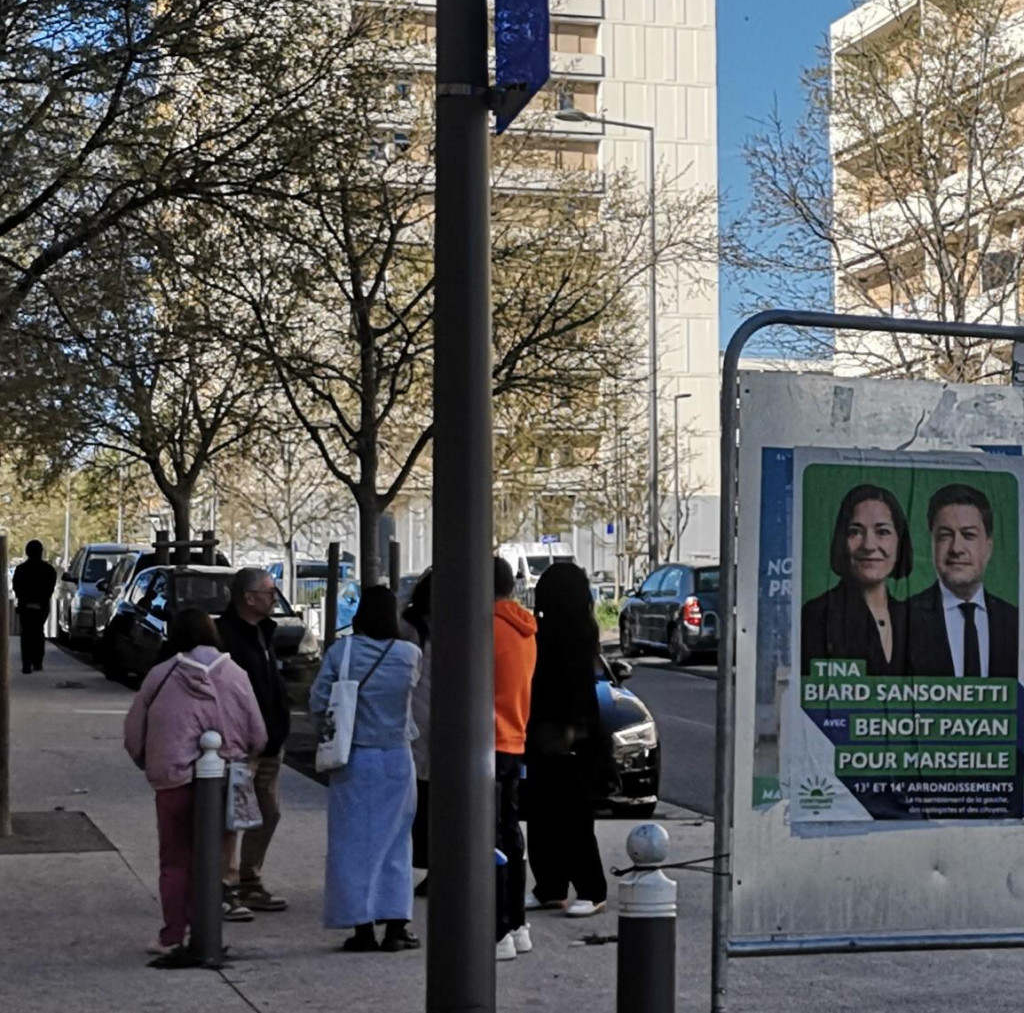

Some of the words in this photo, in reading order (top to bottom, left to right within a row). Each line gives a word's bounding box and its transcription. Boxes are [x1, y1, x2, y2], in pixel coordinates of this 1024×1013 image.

[815, 662, 861, 676] TINA
[804, 684, 870, 701] BIARD
[876, 684, 1007, 702] SANSONETTI
[823, 718, 847, 727] AVEC
[855, 713, 934, 736] BENOÎT
[940, 718, 1008, 736] PAYAN
[838, 752, 897, 769] POUR
[903, 751, 1009, 769] MARSEILLE
[873, 783, 887, 793] ET
[908, 782, 1014, 793] ARRONDISSEMENTS
